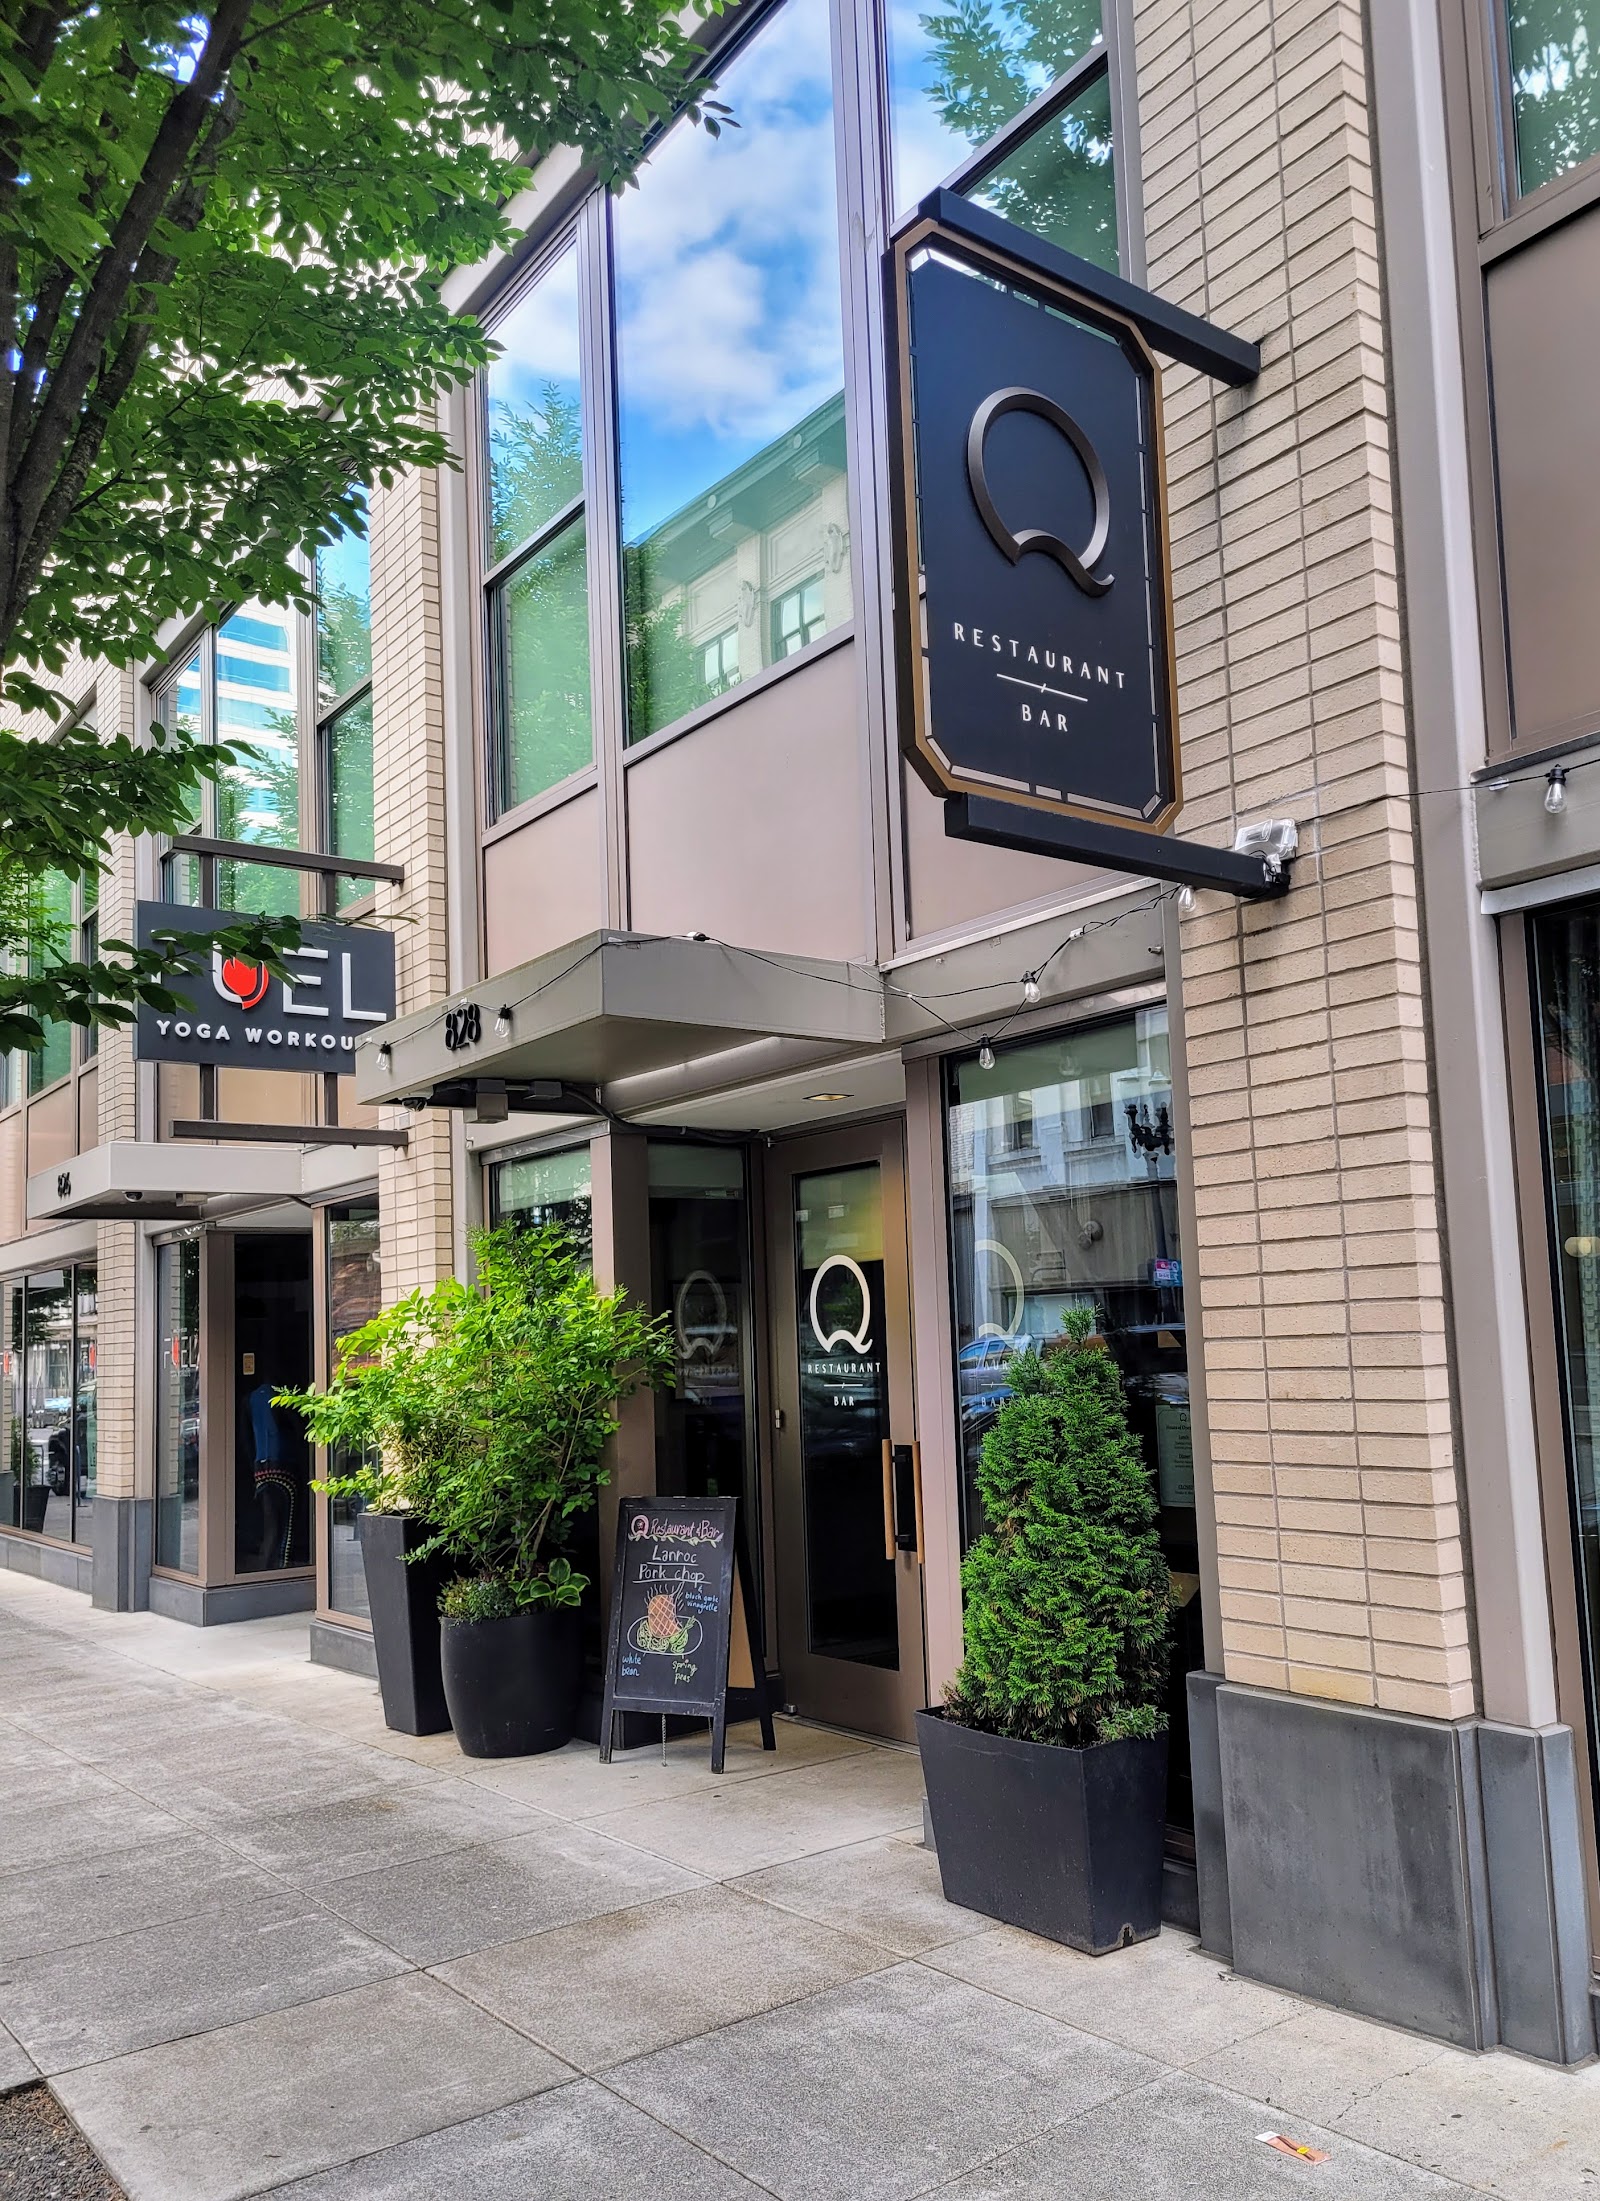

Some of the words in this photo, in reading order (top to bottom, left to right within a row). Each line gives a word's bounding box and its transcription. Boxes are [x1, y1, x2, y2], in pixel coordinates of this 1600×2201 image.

[967, 386, 1116, 598] Q
[954, 622, 1125, 689] RESTAURANT
[1021, 703, 1068, 732] BAR
[151, 930, 387, 1022] UEL
[156, 1019, 231, 1041] YOGA
[244, 1027, 355, 1051] WORKOU
[446, 1003, 481, 1050] 828
[810, 1254, 873, 1355] Q
[807, 1362, 881, 1374] RESTAURANT
[833, 1396, 855, 1407] BAR
[981, 1396, 1006, 1408] BAR
[651, 1518, 695, 1538] Restaurant
[700, 1520, 720, 1539] Bar
[652, 1545, 697, 1563] Lanroc
[639, 1564, 666, 1579] Pork
[674, 1565, 705, 1588] chop
[622, 1652, 641, 1665] white
[621, 1665, 640, 1676] bean
[674, 1673, 691, 1685] peas
